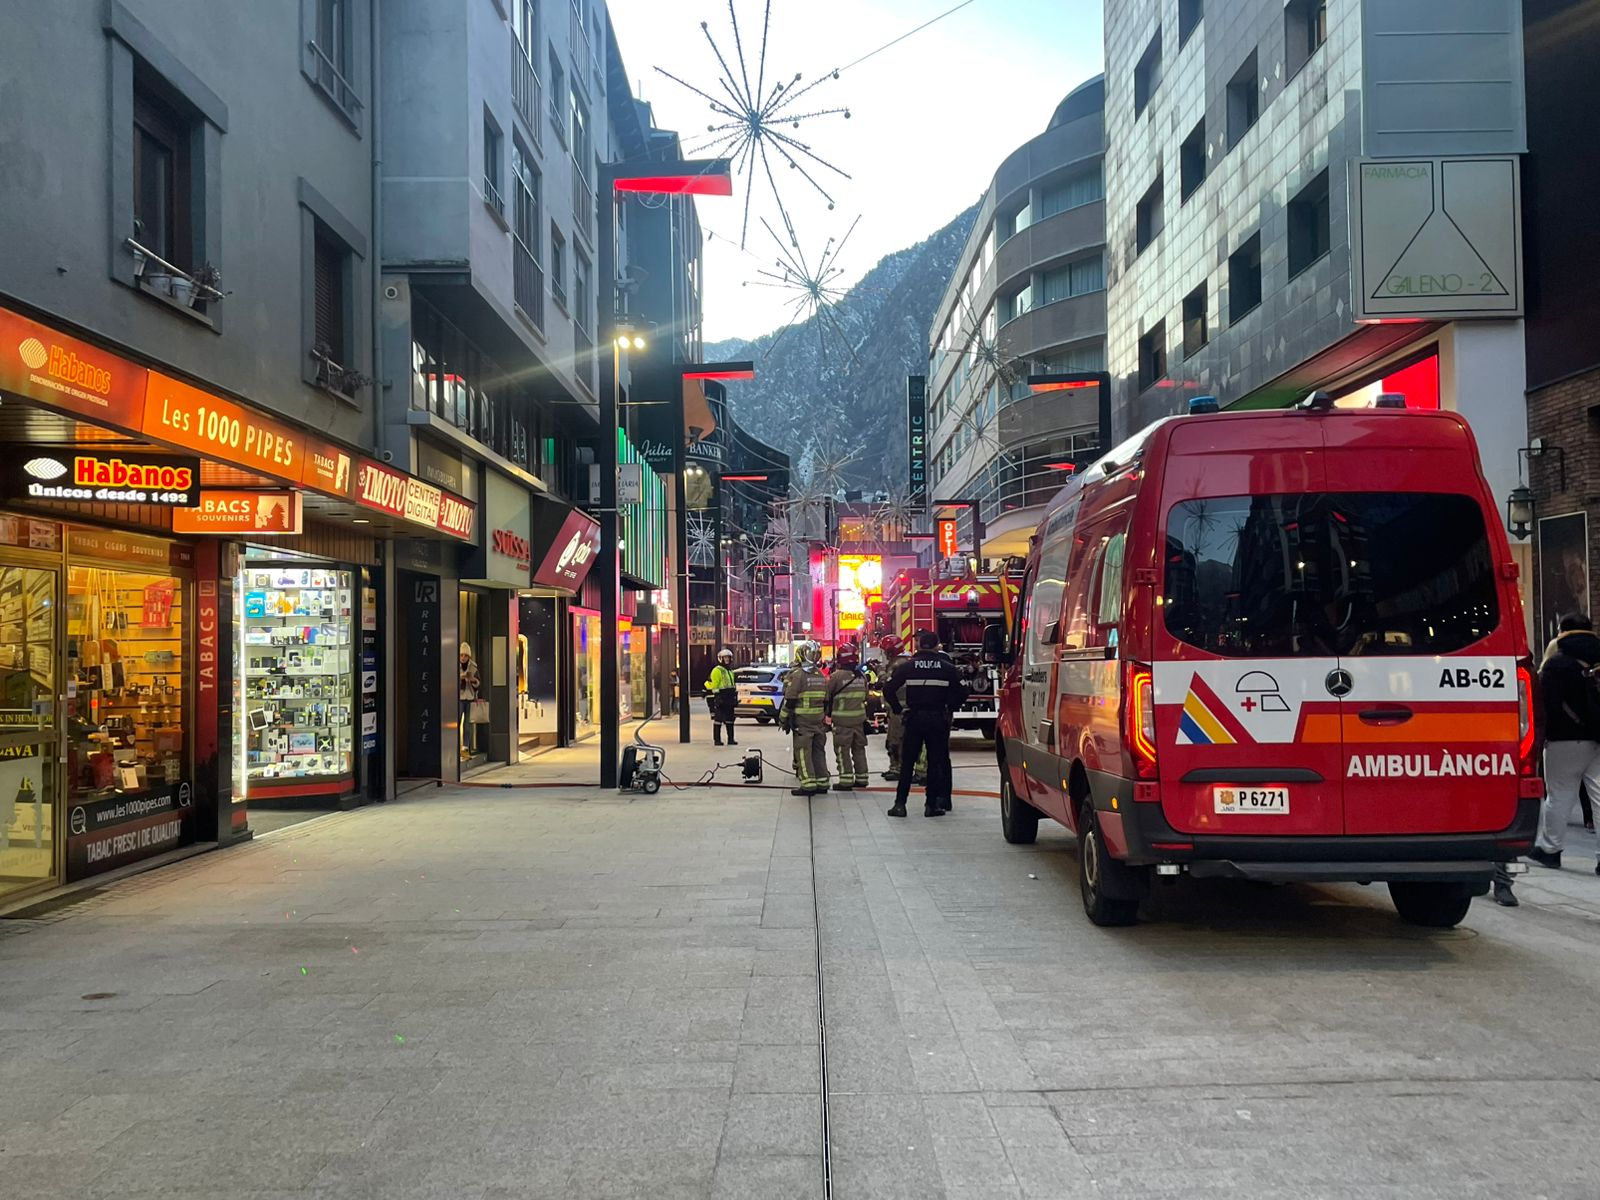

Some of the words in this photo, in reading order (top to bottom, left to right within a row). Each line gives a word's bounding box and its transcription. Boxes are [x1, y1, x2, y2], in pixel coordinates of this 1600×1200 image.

[1364, 167, 1429, 179] FARMACIA
[1386, 273, 1462, 295] GALENO
[1479, 272, 1493, 292] 2
[48, 344, 112, 395] Habanos
[162, 399, 190, 432] Les
[197, 407, 240, 449] 1000
[244, 424, 293, 467] PIPES
[74, 456, 192, 491] Habanos
[313, 453, 335, 471] TABACS
[28, 483, 93, 499] Únicos
[95, 488, 147, 501] desde
[151, 492, 188, 503] 1492
[408, 482, 440, 507] CENTRE
[196, 514, 250, 522] SOUVENIRS
[406, 500, 437, 523] DIGITAL
[199, 607, 214, 691] TABACS
[1438, 668, 1505, 690] AB-62
[1346, 748, 1517, 778] AMBULÀNCIA
[96, 795, 172, 822] www.les1000pipes.com
[1239, 791, 1247, 807] P
[1250, 791, 1284, 807] 6271
[86, 838, 112, 863] TABAC
[113, 831, 136, 855] FRESC
[141, 827, 151, 847] DE
[151, 819, 182, 844] QUALITAT
